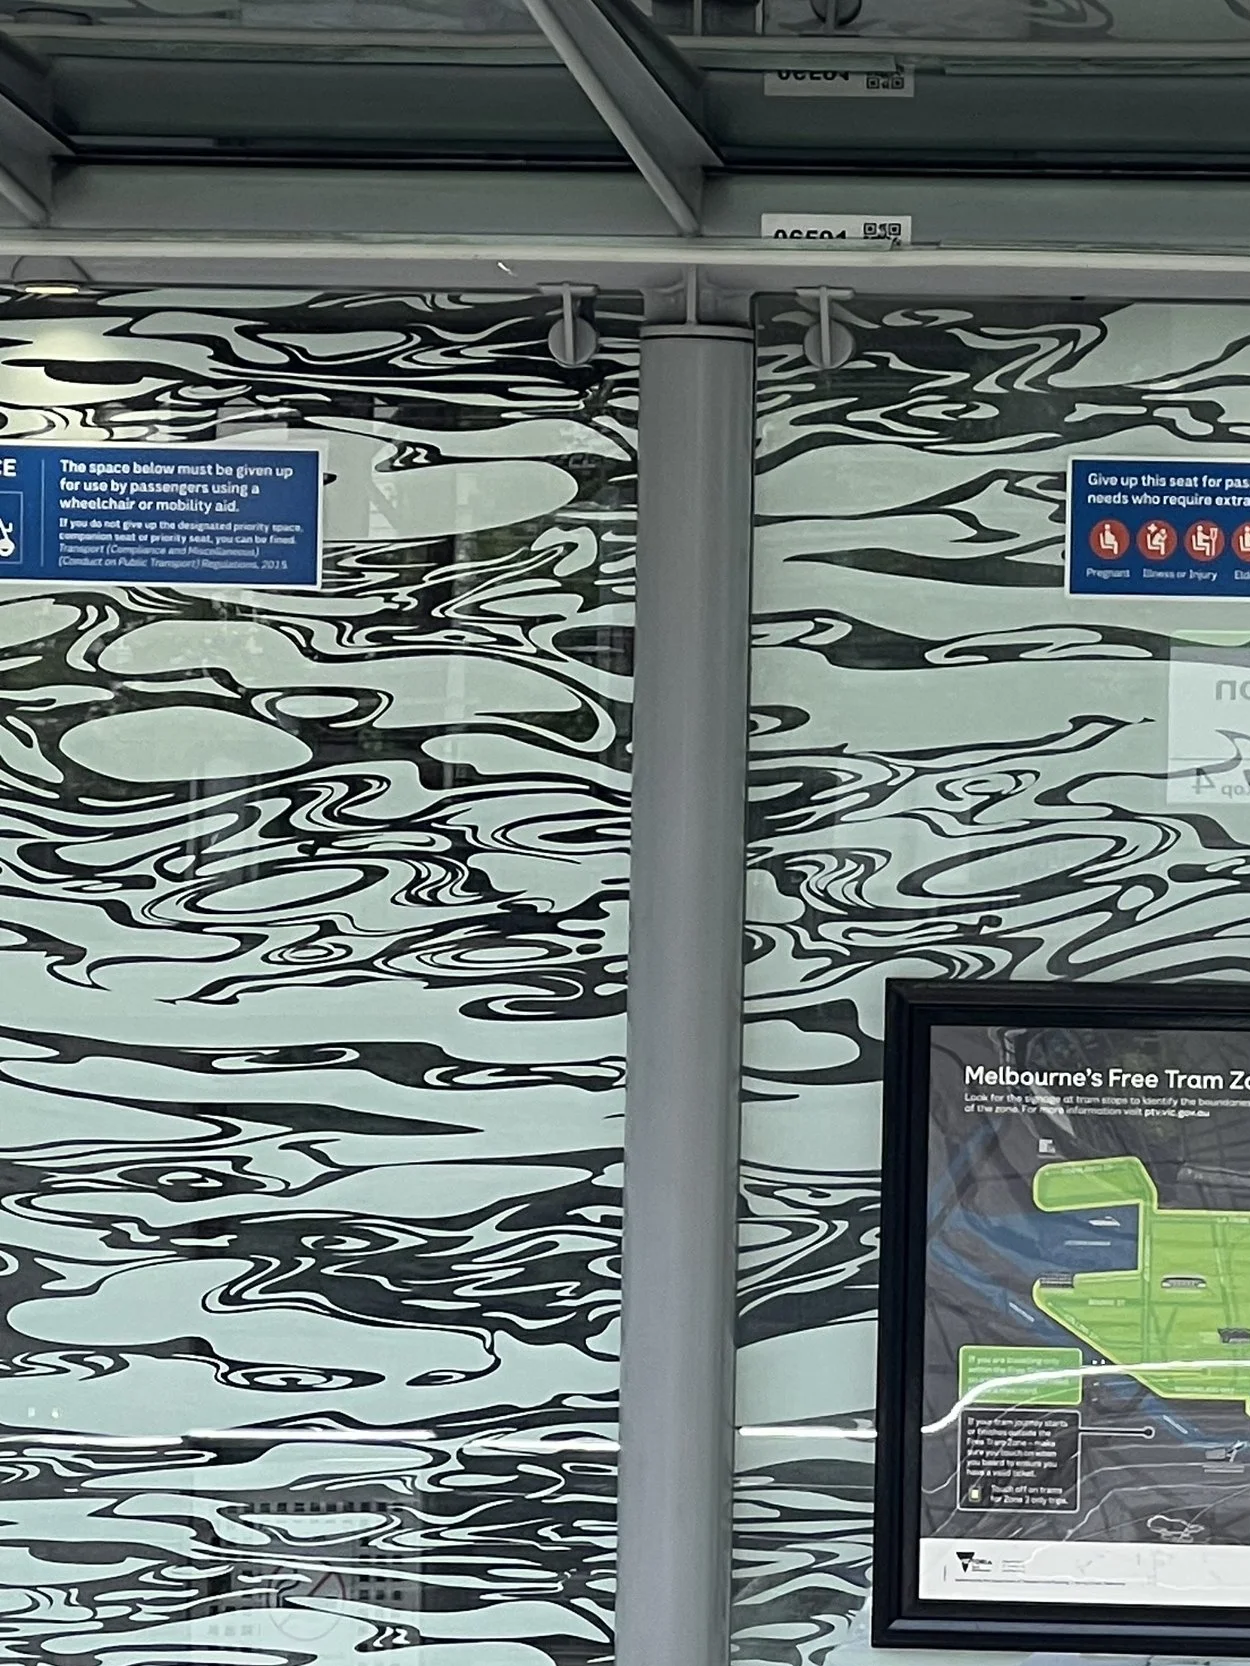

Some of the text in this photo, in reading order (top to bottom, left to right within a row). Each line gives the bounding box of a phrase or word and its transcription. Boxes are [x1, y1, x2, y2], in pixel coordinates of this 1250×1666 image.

[0, 459, 17, 477] E
[60, 459, 293, 479] The space below must be given up
[60, 477, 260, 498] for use by passengers using a
[1088, 473, 1118, 486] Give
[1120, 475, 1138, 489] up
[1141, 474, 1166, 487] this
[1169, 476, 1198, 488] seat
[1202, 475, 1222, 488] for
[60, 496, 240, 515] wheelchair or mobility aid.
[1087, 492, 1129, 505] needs
[1131, 492, 1160, 505] who
[1163, 493, 1212, 508] require
[60, 518, 68, 528] If
[70, 520, 88, 530] you
[89, 519, 102, 528] do
[104, 520, 121, 529] not
[123, 521, 143, 531] give
[145, 522, 157, 531] up
[160, 521, 175, 530] the
[178, 521, 232, 532] designated
[233, 523, 269, 533] priority
[1086, 568, 1130, 579] Pregnant
[1143, 568, 1175, 578] Illness
[1190, 569, 1217, 581] Injury
[965, 1066, 1103, 1087] Melbourne's
[1109, 1069, 1158, 1088] Free
[1165, 1069, 1223, 1089] Tram
